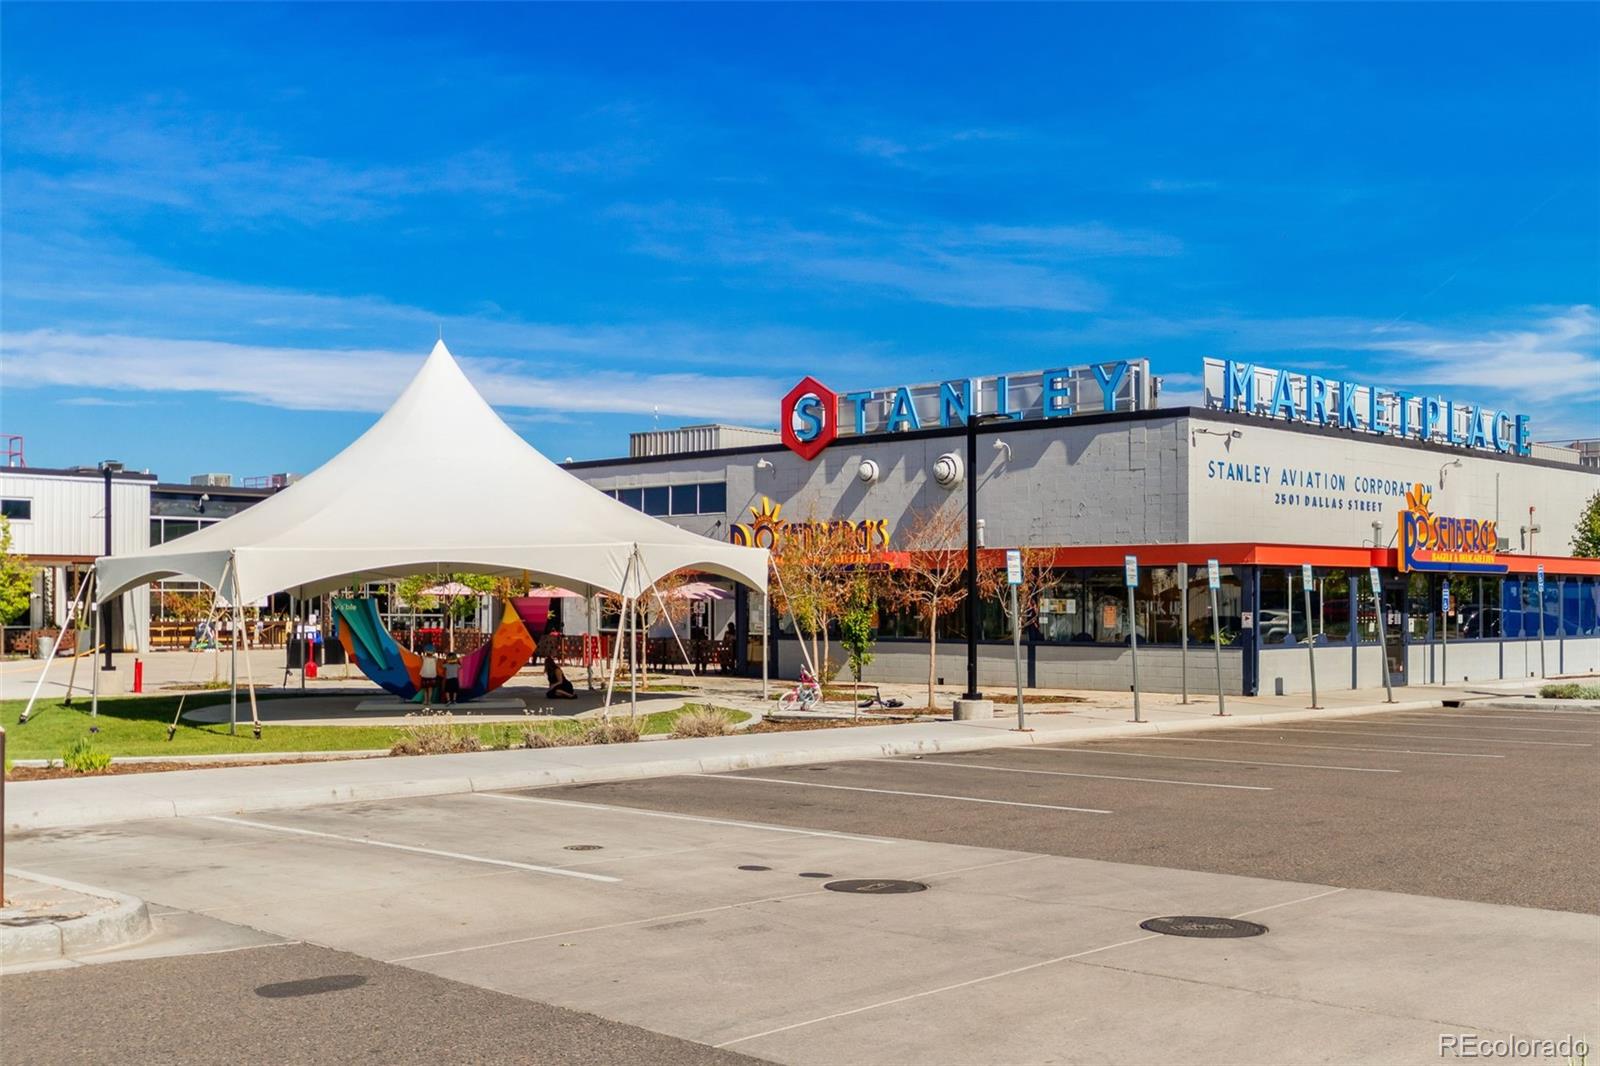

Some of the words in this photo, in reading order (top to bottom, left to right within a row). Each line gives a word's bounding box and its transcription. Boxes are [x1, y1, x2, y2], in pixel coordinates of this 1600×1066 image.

[796, 361, 1128, 442] STANLEY
[1224, 360, 1532, 456] MARKETPLACE
[1208, 460, 1271, 484] STANLEY
[1281, 469, 1346, 491] AVIATION
[1355, 476, 1433, 498] CORPORATN
[1275, 493, 1300, 506] 2501
[1304, 496, 1343, 510] DALLAS
[1348, 500, 1383, 512] STREET
